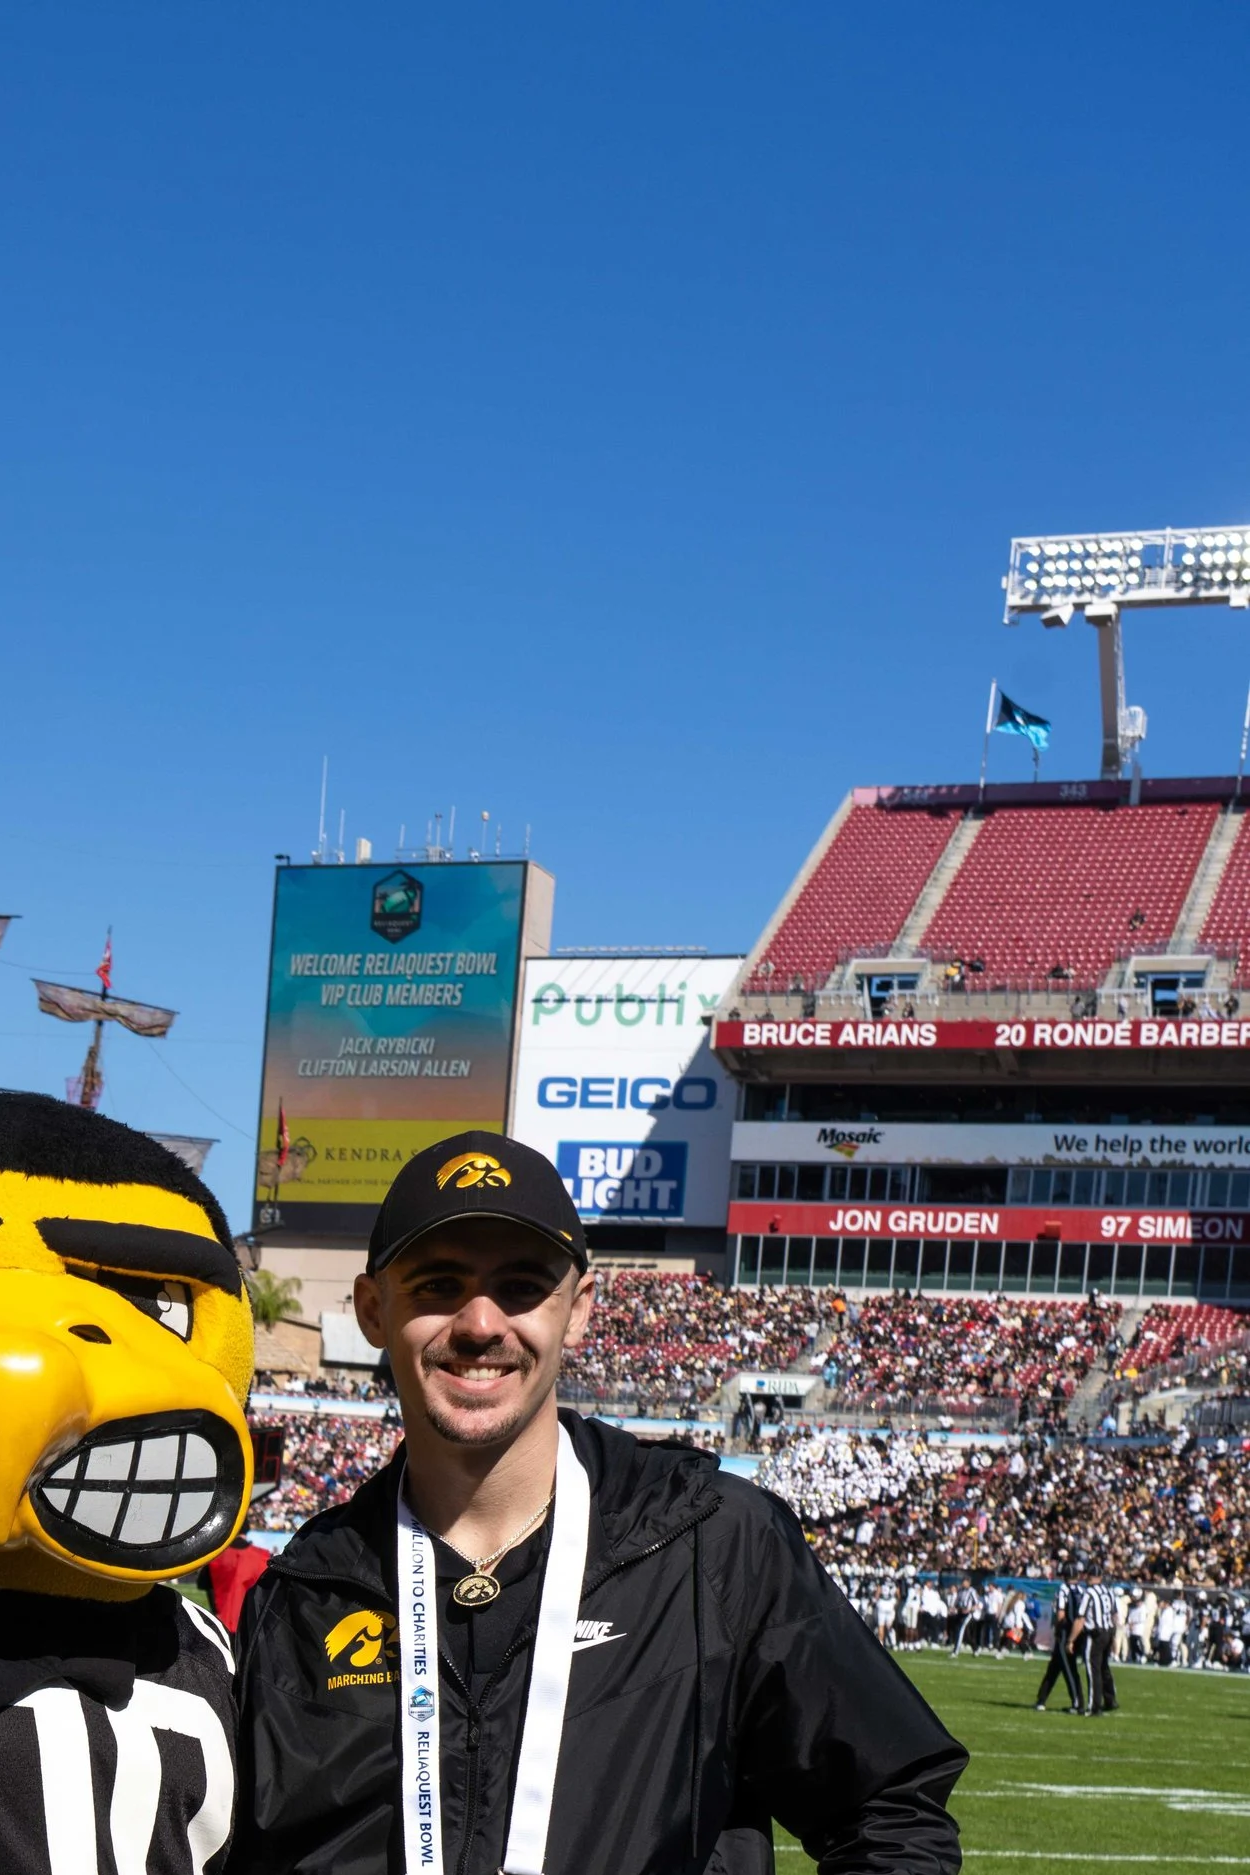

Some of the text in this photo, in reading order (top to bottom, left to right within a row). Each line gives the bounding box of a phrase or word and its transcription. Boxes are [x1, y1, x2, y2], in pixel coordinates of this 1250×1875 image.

[1059, 784, 1087, 798] 343
[290, 952, 497, 980] WELCOME RELIAQUEST BOWL
[321, 983, 464, 1006] VIP CLUB MEMBERS
[531, 982, 720, 1026] Publix
[743, 1023, 937, 1046] BRUCE ARIANS
[995, 1023, 1026, 1046] 20
[338, 1037, 435, 1057] JACK RYBICKI
[298, 1059, 471, 1076] CLIFTON LARSON ALLEN
[537, 1077, 717, 1110] GEICO
[817, 1128, 883, 1145] Mosaic
[1054, 1134, 1088, 1152] We
[1095, 1134, 1142, 1158] help
[1150, 1134, 1186, 1154] the
[325, 1147, 403, 1161] KENDRA
[578, 1147, 663, 1178] BUD
[829, 1210, 999, 1234] JON GRUDEN
[1101, 1216, 1243, 1239] 97 SIMEON
[411, 1518, 427, 1675] MILLION TO CHARITIES
[328, 1672, 384, 1690] MARCHING
[416, 1731, 431, 1818] RELIAQUEST
[420, 1823, 433, 1867] BOWL
